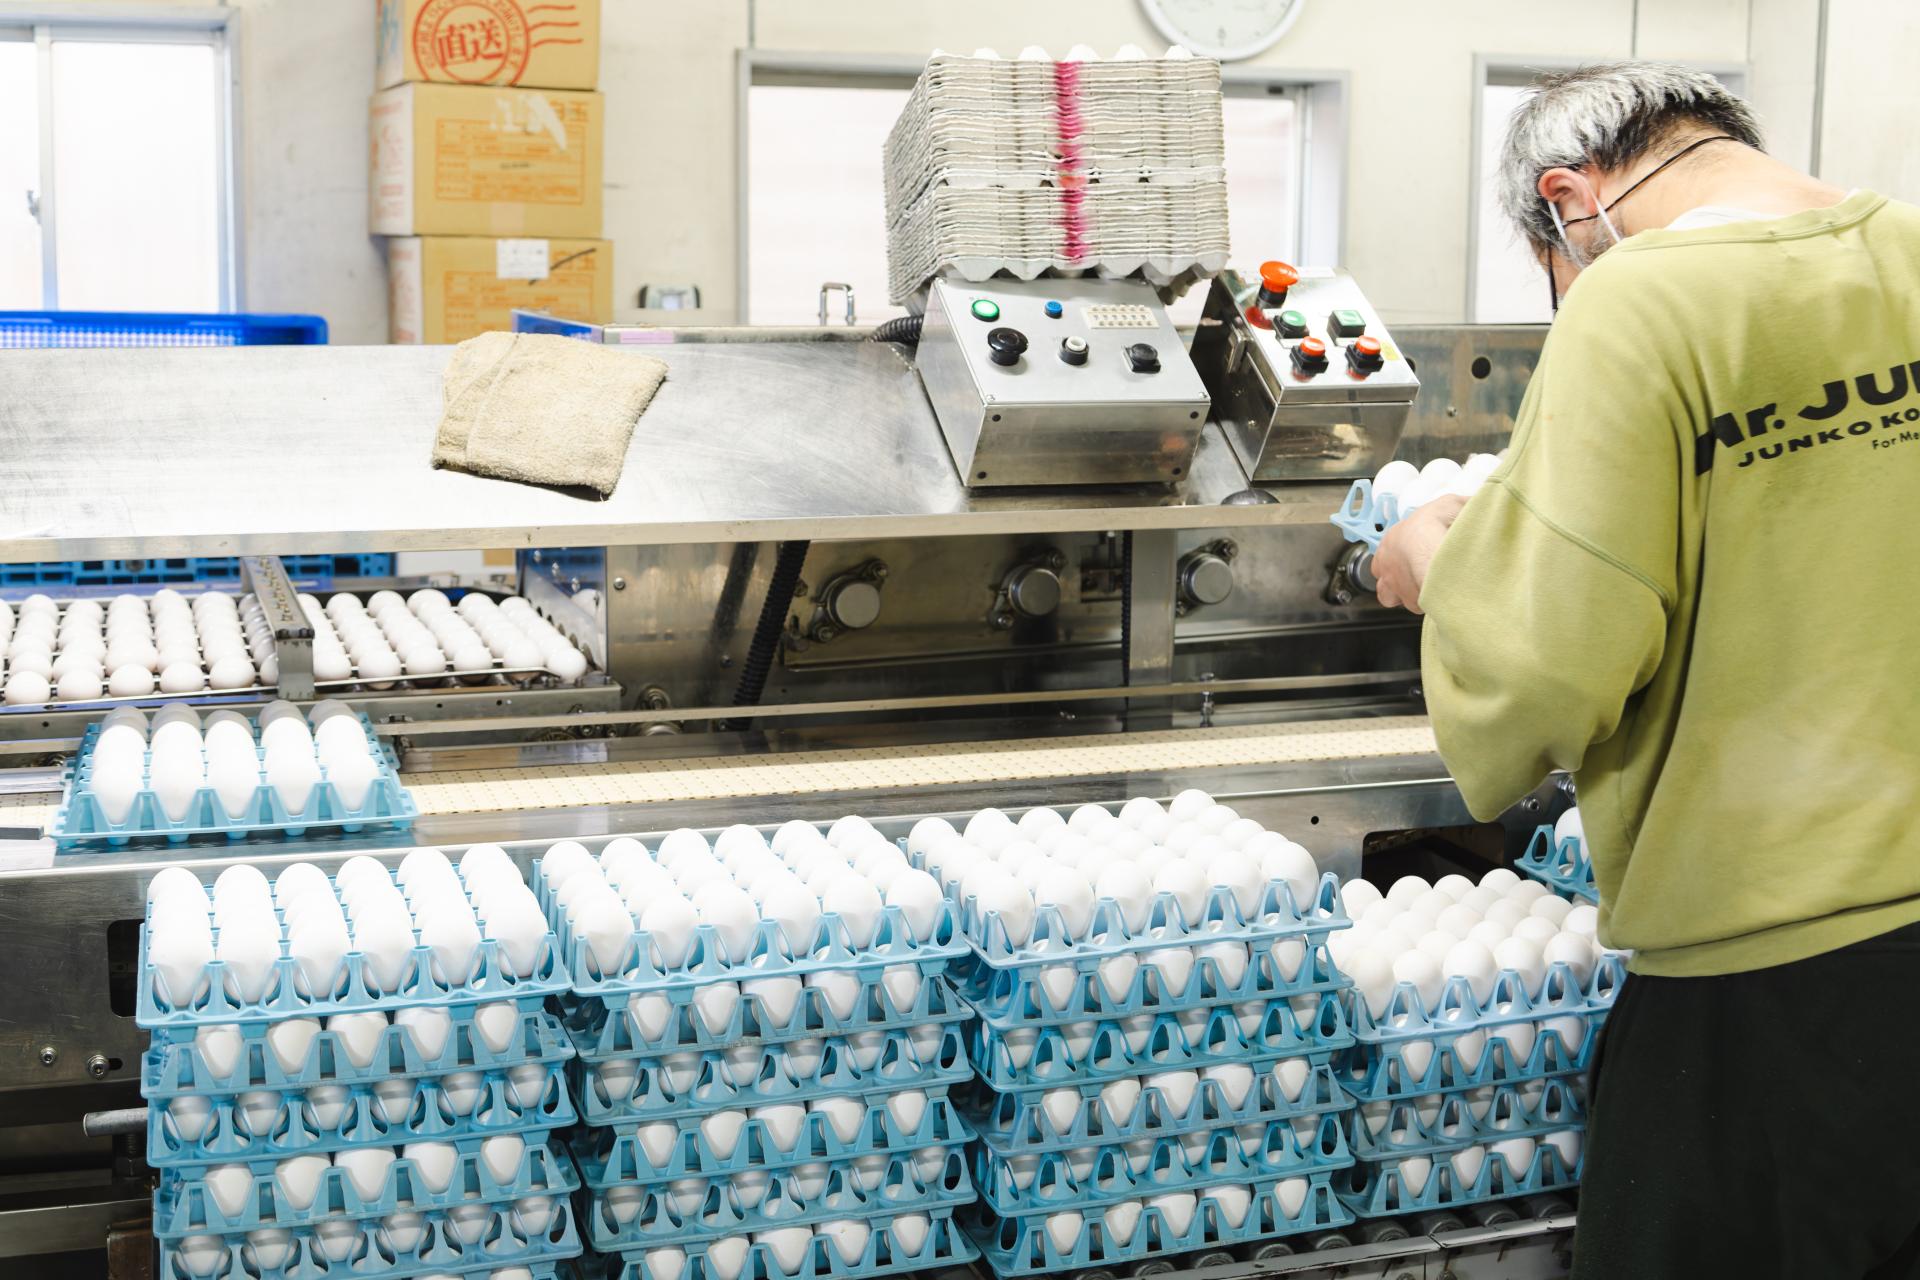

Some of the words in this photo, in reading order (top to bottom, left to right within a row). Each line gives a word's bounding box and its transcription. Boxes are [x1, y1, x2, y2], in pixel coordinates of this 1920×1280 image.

[438, 18, 504, 68] 直送
[1798, 360, 1920, 420] JU
[1738, 421, 1872, 468] JUNKO
[1872, 438, 1896, 450] For
